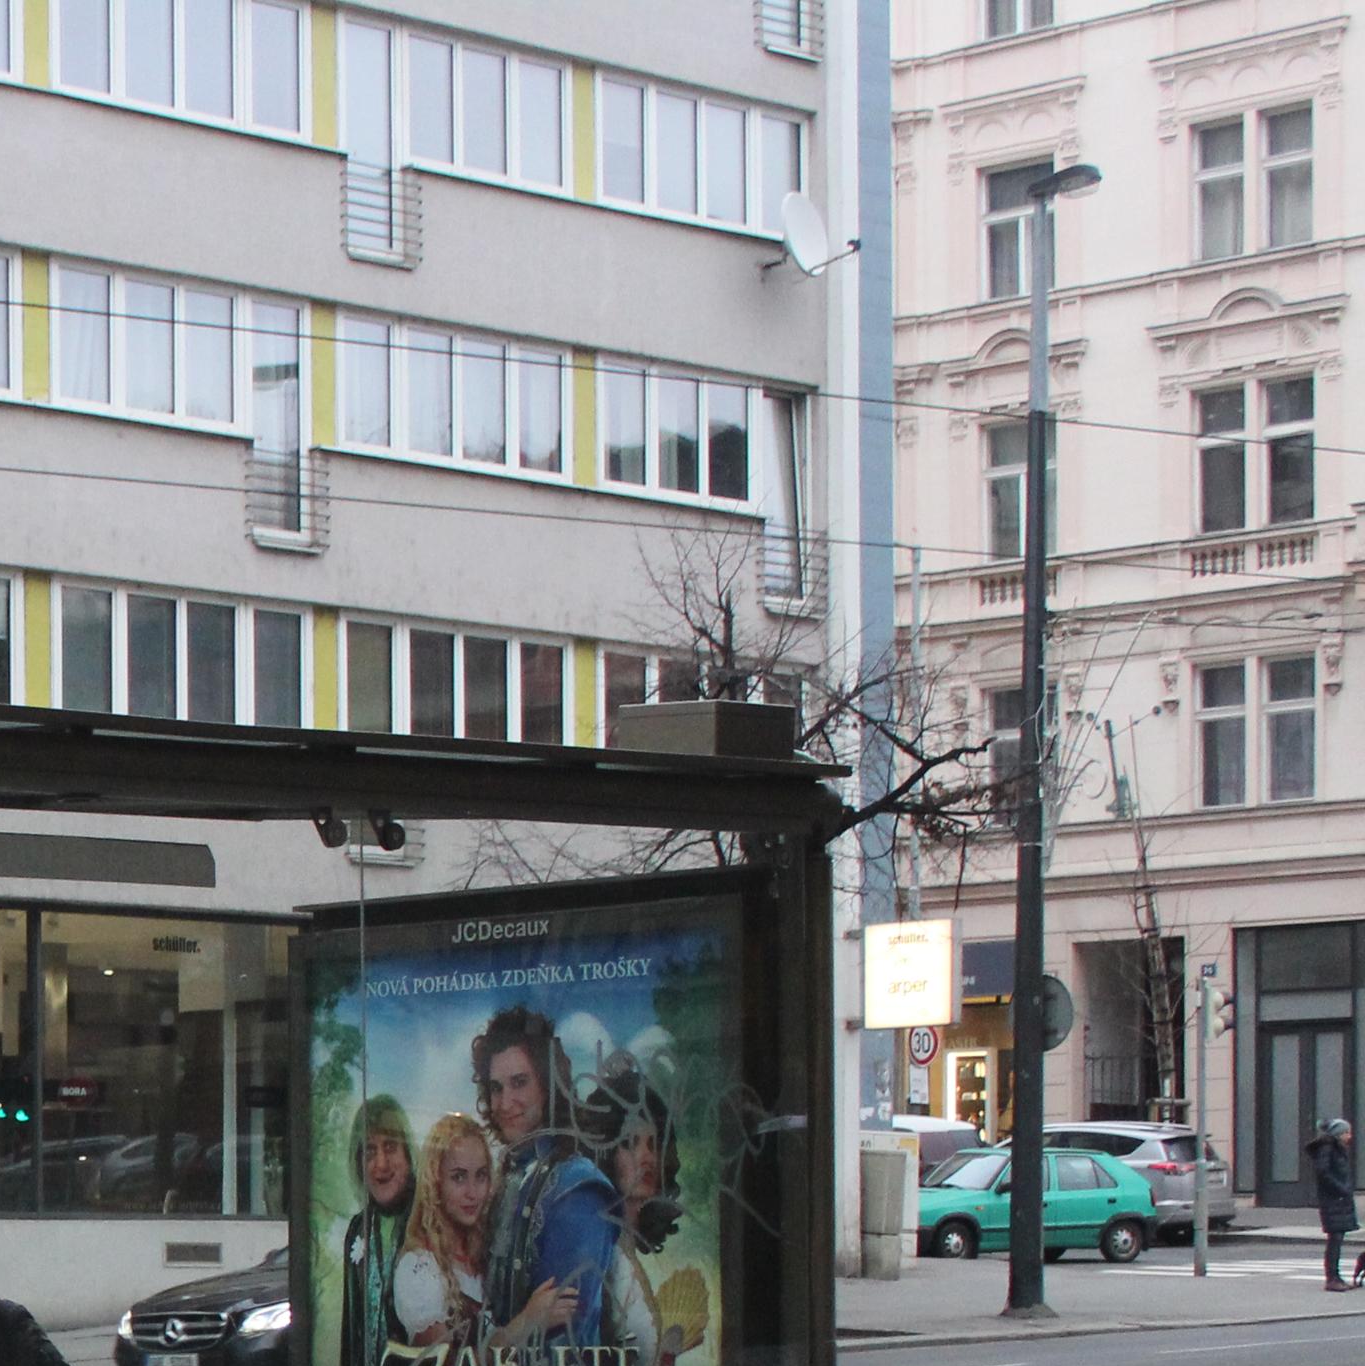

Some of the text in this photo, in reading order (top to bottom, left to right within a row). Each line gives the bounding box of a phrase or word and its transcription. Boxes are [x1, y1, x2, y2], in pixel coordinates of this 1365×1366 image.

[452, 918, 550, 943] JCDecaux
[367, 956, 651, 998] NOVÁ POHÁDKA ZDEŇKA TROŠKY
[914, 1032, 931, 1053] 30
